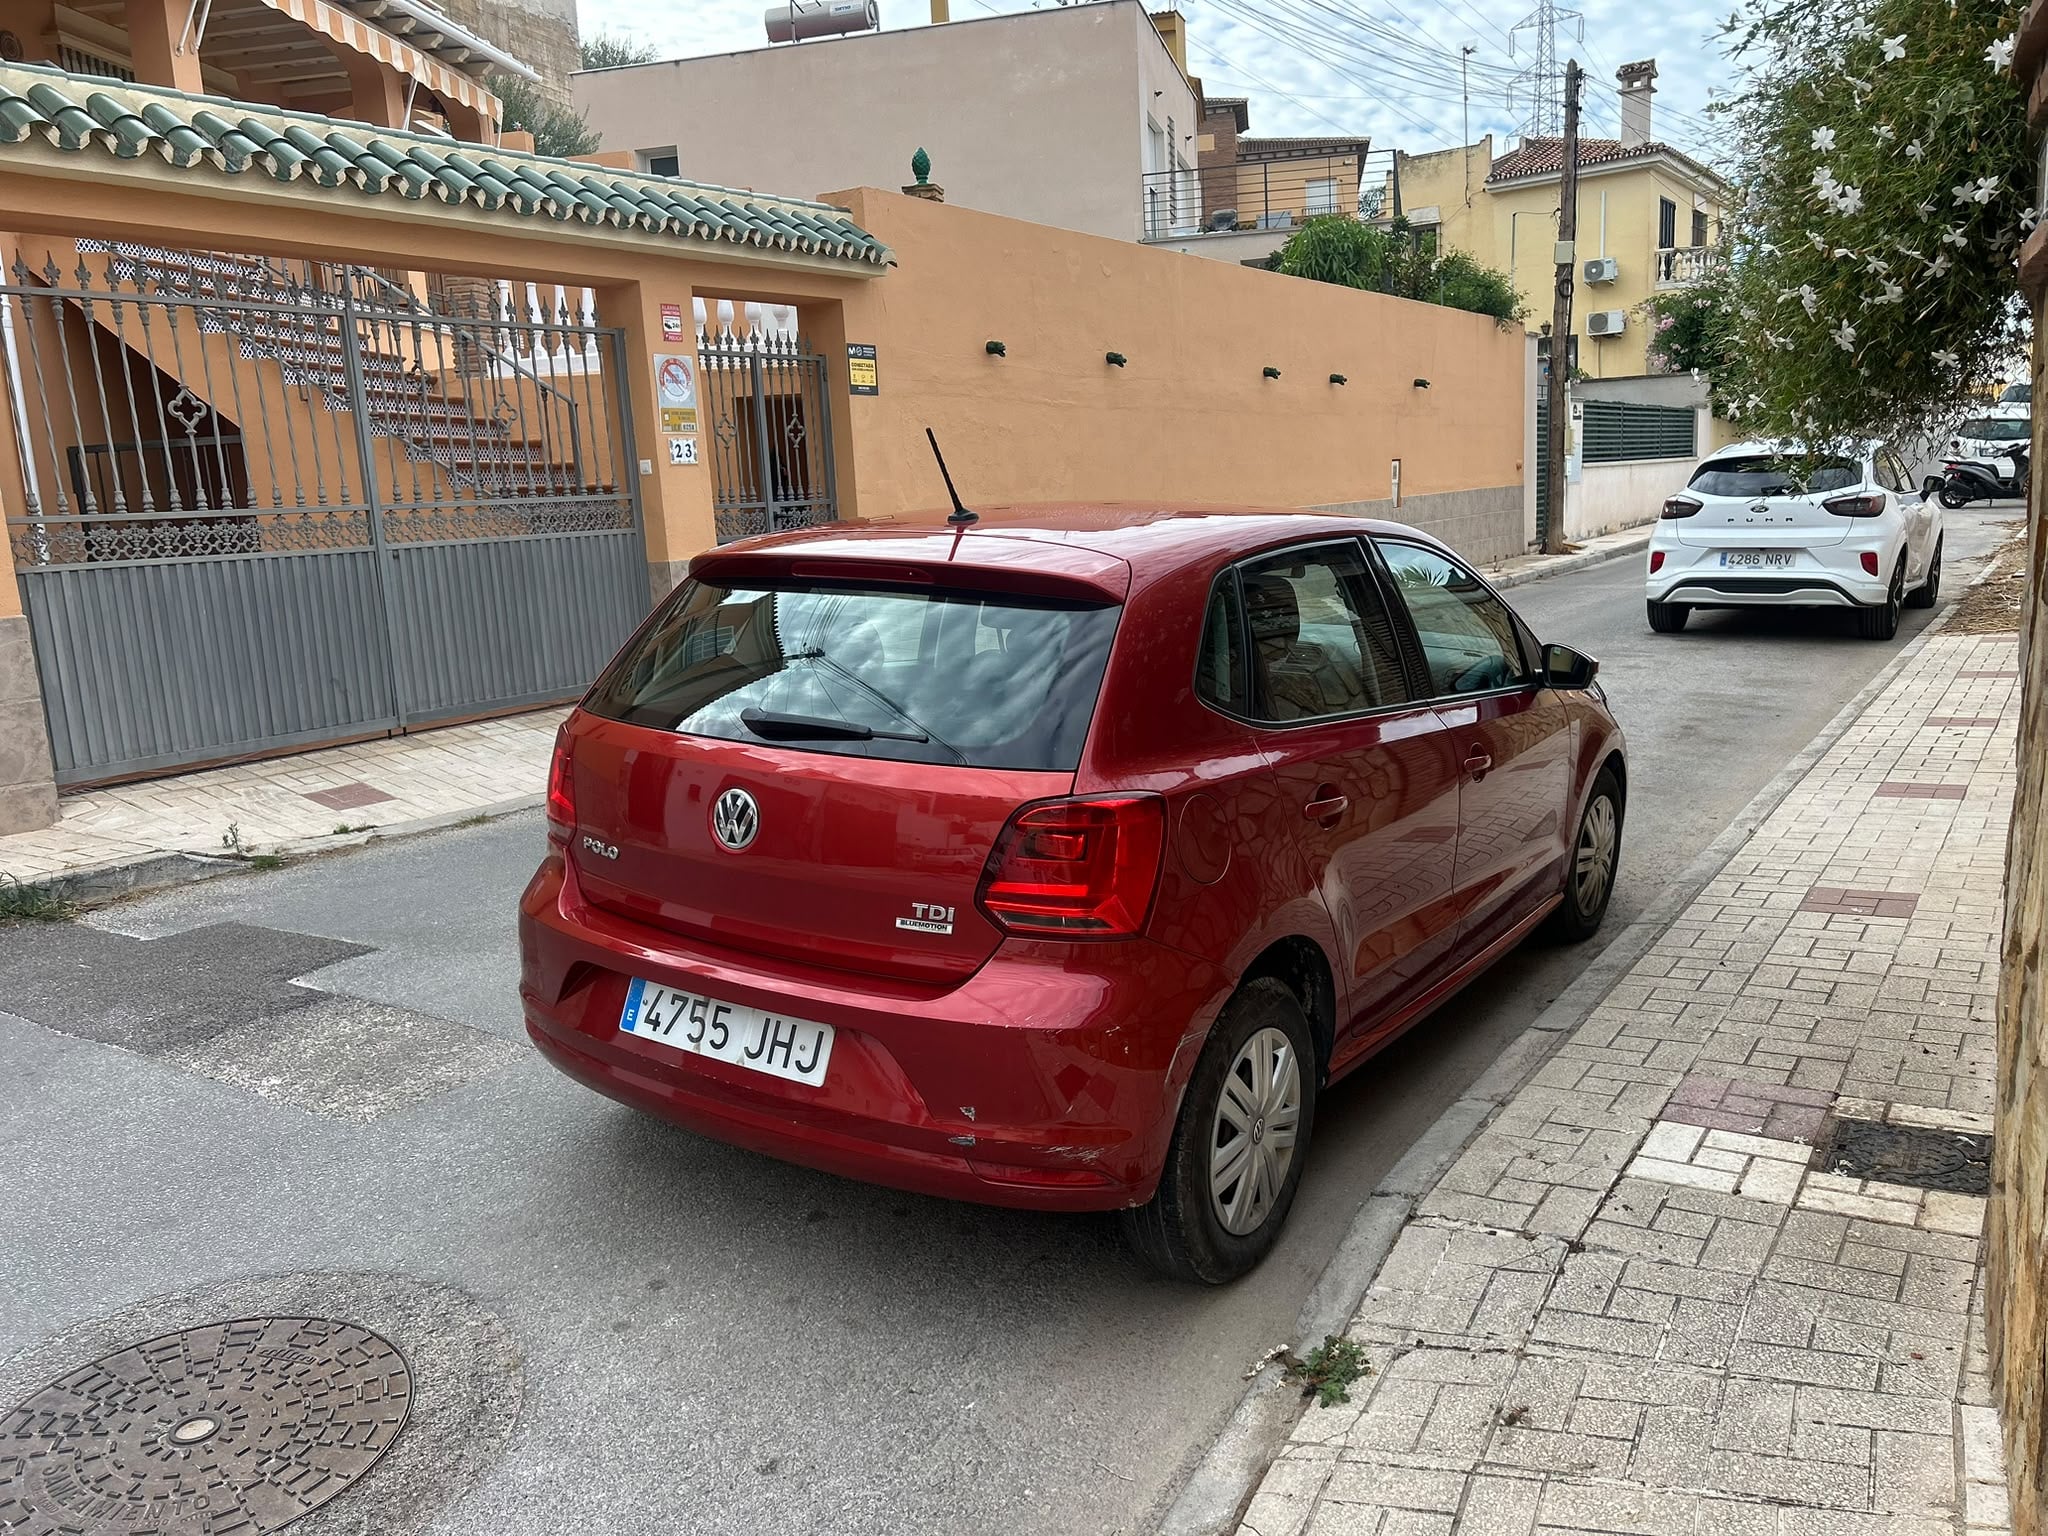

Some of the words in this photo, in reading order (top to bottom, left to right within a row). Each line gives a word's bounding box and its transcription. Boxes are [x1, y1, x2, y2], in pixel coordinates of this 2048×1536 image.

[675, 444, 692, 458] 23
[1728, 554, 1760, 565] 4286
[1765, 553, 1792, 565] NRV
[583, 836, 619, 860] POLO
[912, 902, 955, 922] TDI
[900, 919, 948, 931] BLUEMOTION
[626, 1009, 635, 1021] E
[643, 989, 731, 1050] 4755
[744, 1017, 825, 1073] JHJ
[42, 1463, 211, 1522] SANEAMIENTO
